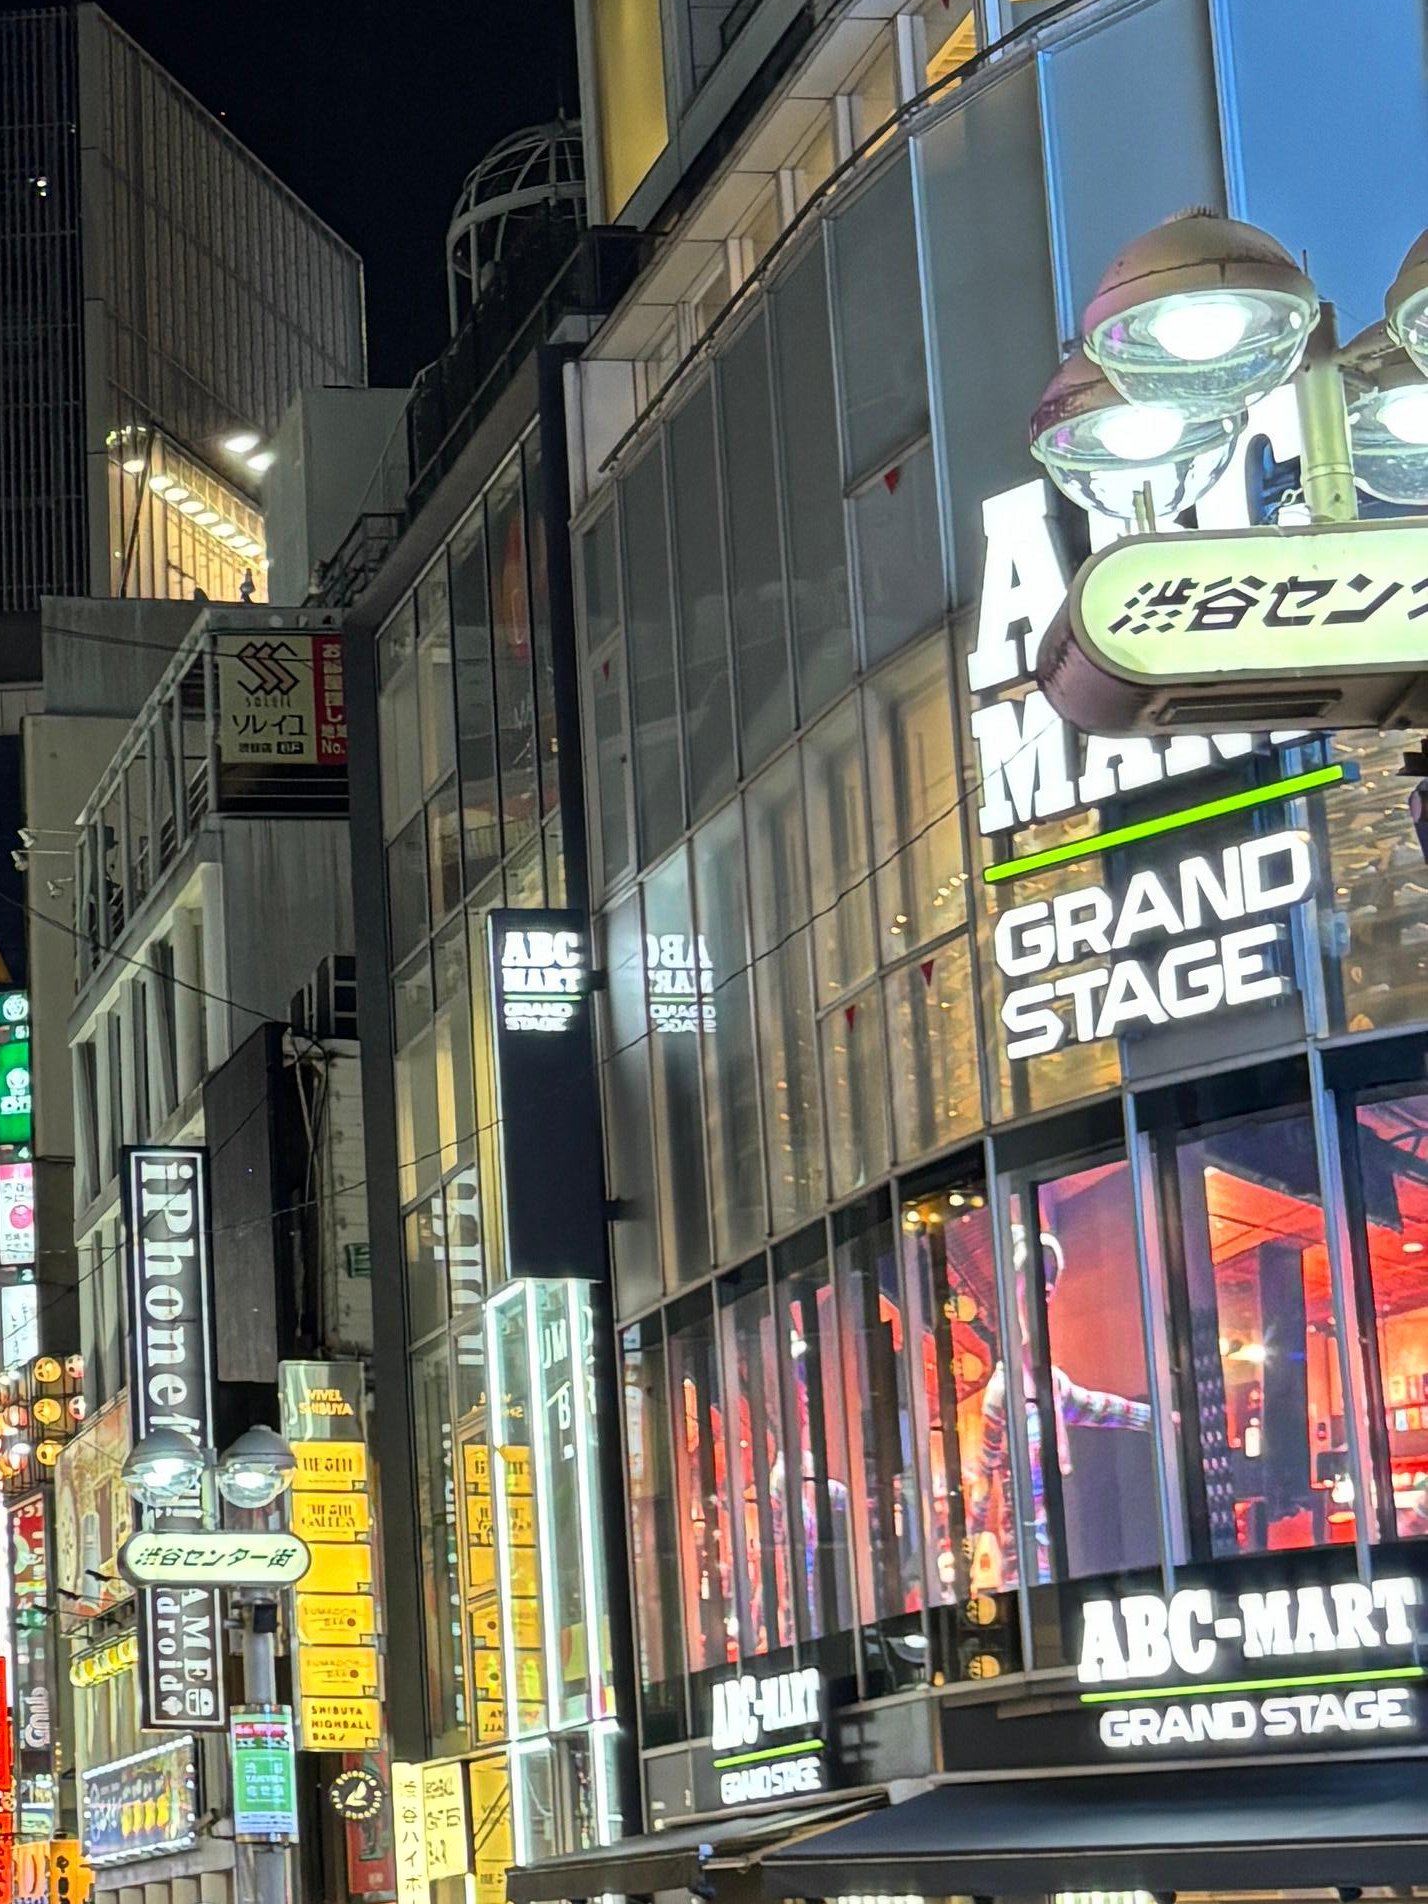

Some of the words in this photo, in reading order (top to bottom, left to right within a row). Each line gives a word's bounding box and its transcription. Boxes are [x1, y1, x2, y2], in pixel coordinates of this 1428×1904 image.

[232, 714, 307, 736] ソレイユ
[993, 829, 1311, 978] GRAND
[501, 931, 580, 967] ABC
[501, 968, 583, 993] MART
[1001, 922, 1289, 1060] STAGE
[135, 1547, 297, 1569] 渋谷センター街
[157, 1594, 183, 1692] droid
[181, 1587, 213, 1682] AME
[1076, 1576, 1422, 1684] ABC-MART
[711, 1667, 822, 1752] ABC-MART
[1099, 1700, 1256, 1749] GRAND
[1262, 1688, 1411, 1736] STAGE
